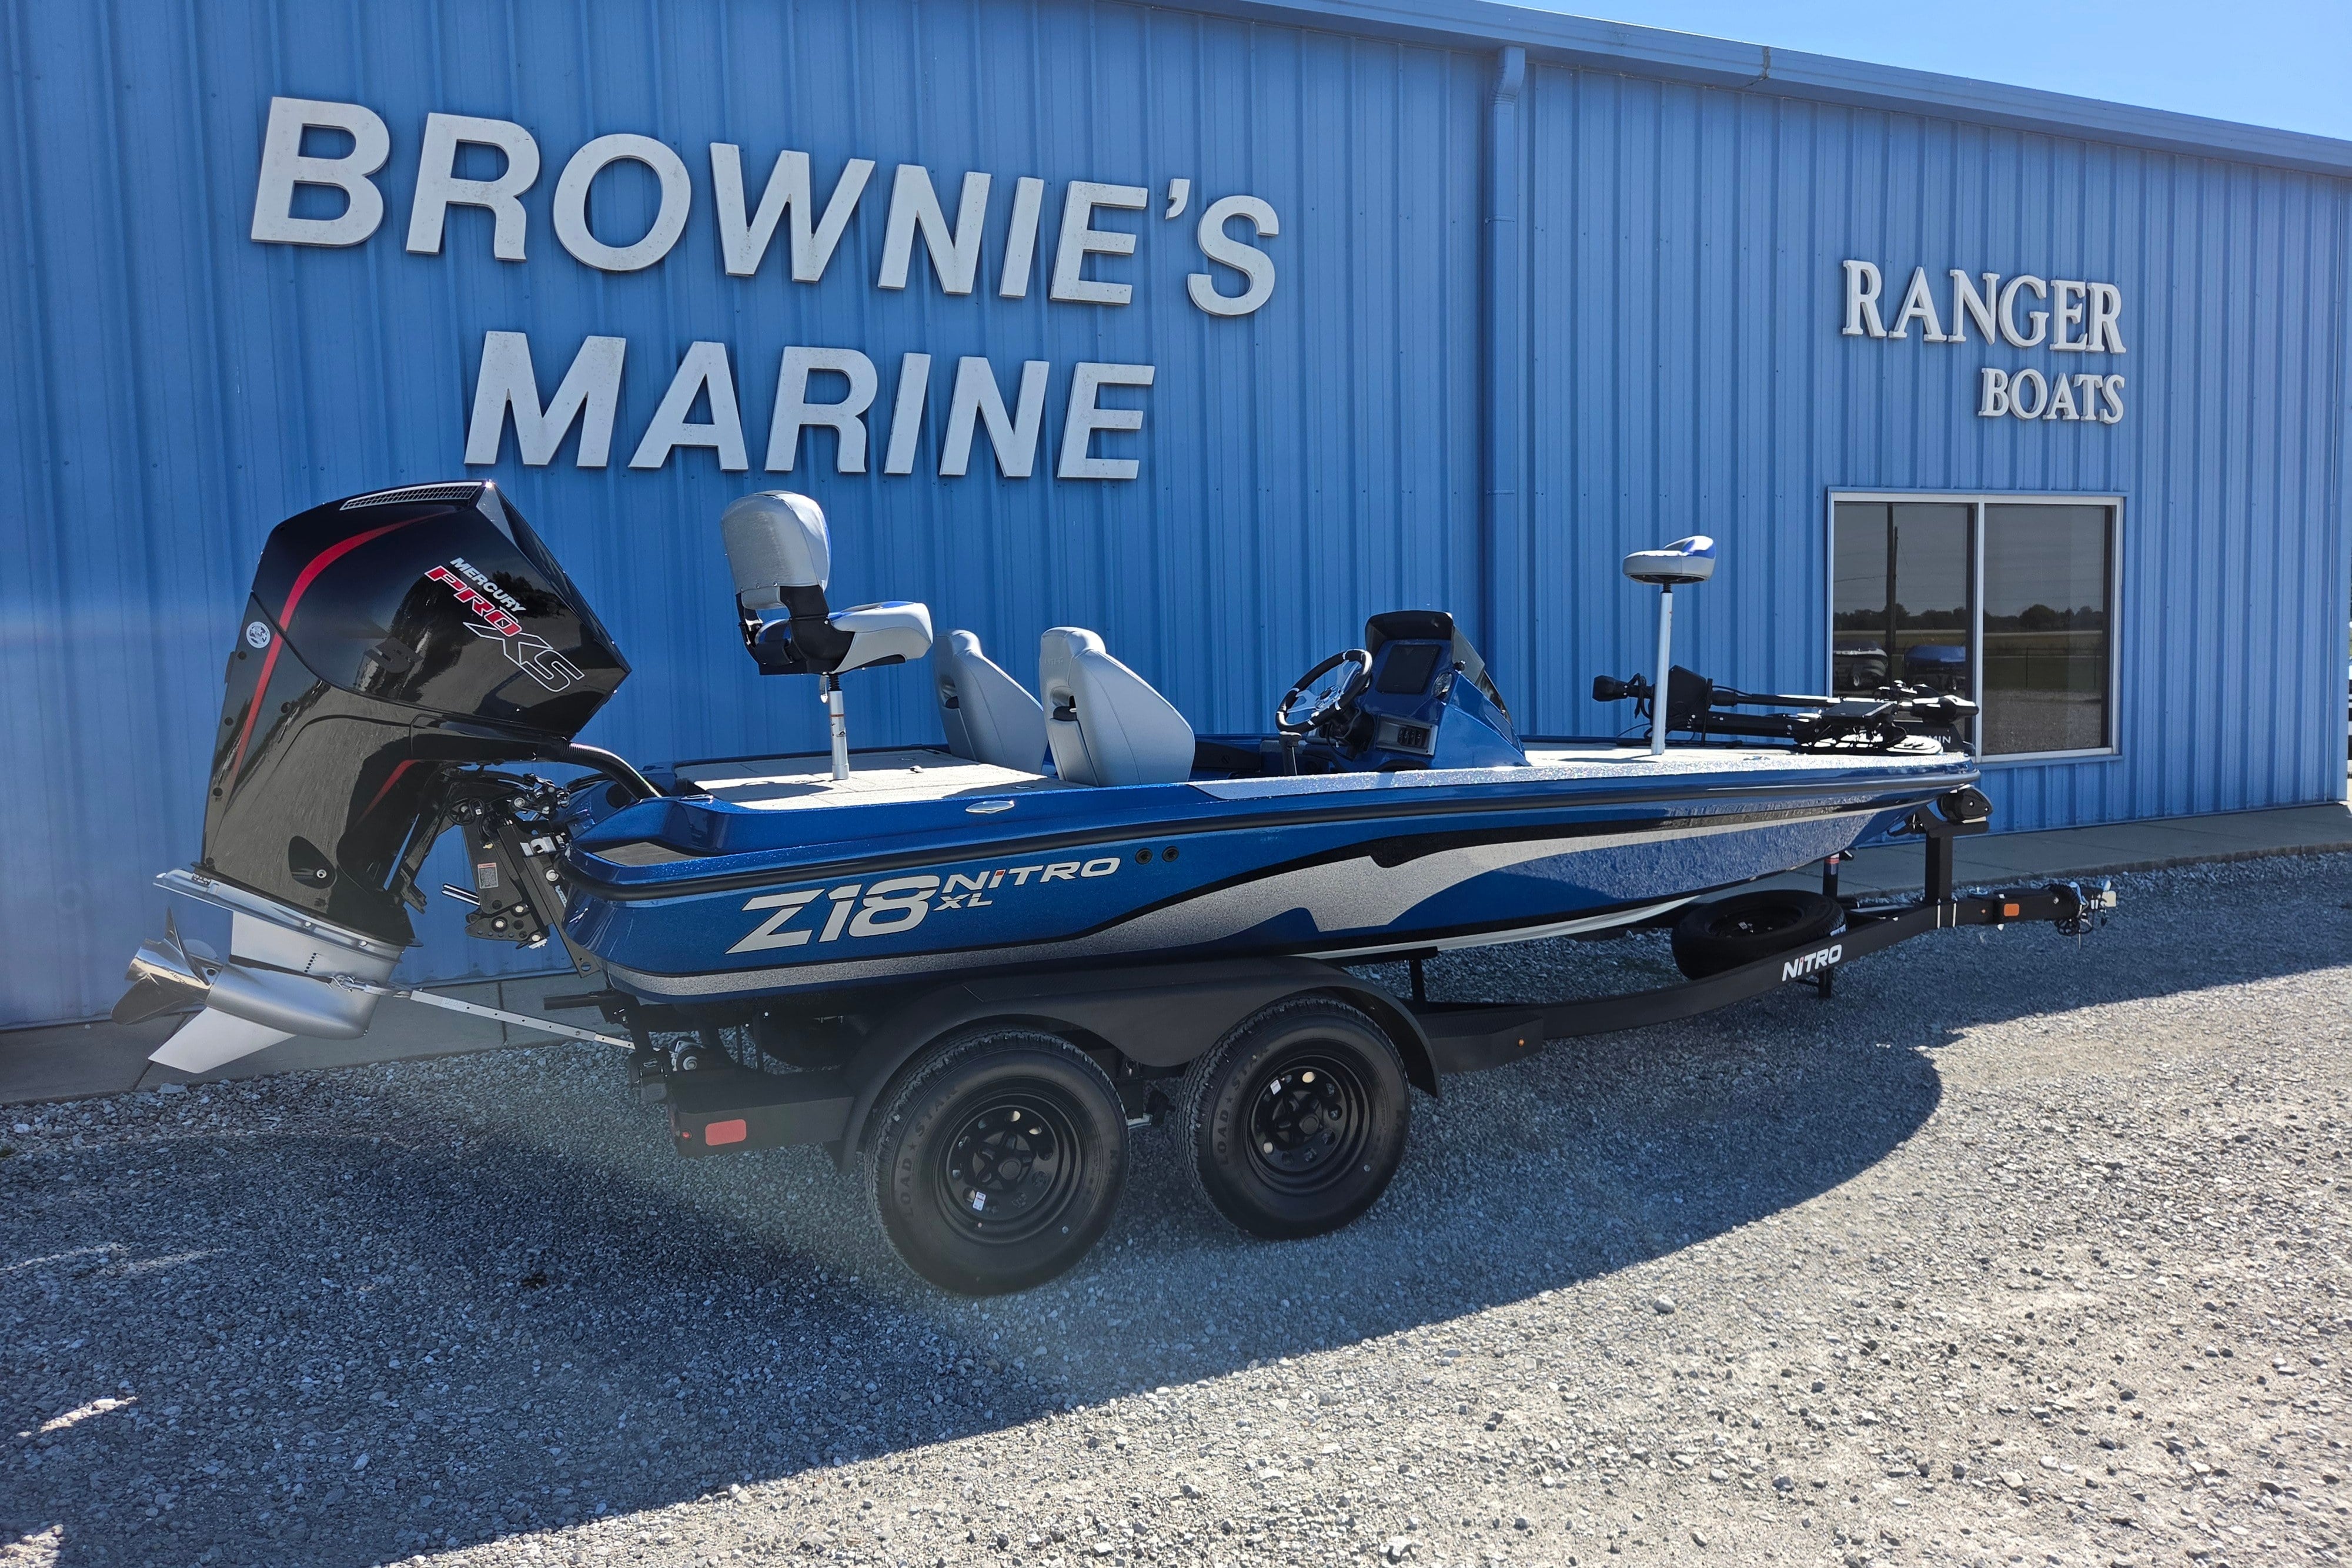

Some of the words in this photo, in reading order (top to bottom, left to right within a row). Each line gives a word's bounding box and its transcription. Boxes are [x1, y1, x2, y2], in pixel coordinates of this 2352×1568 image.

[250, 96, 1279, 316] BROWNIE'S
[1842, 259, 2126, 354] RANGER
[463, 330, 1156, 479] MARINE
[1978, 367, 2125, 424] BOATS
[424, 565, 523, 637] PRO
[450, 557, 527, 611] MERCURY
[462, 606, 585, 693] XS
[724, 875, 941, 954] Z18
[942, 857, 1121, 894] NITRO
[933, 893, 994, 911] XL
[1782, 944, 1842, 982] NITRO
